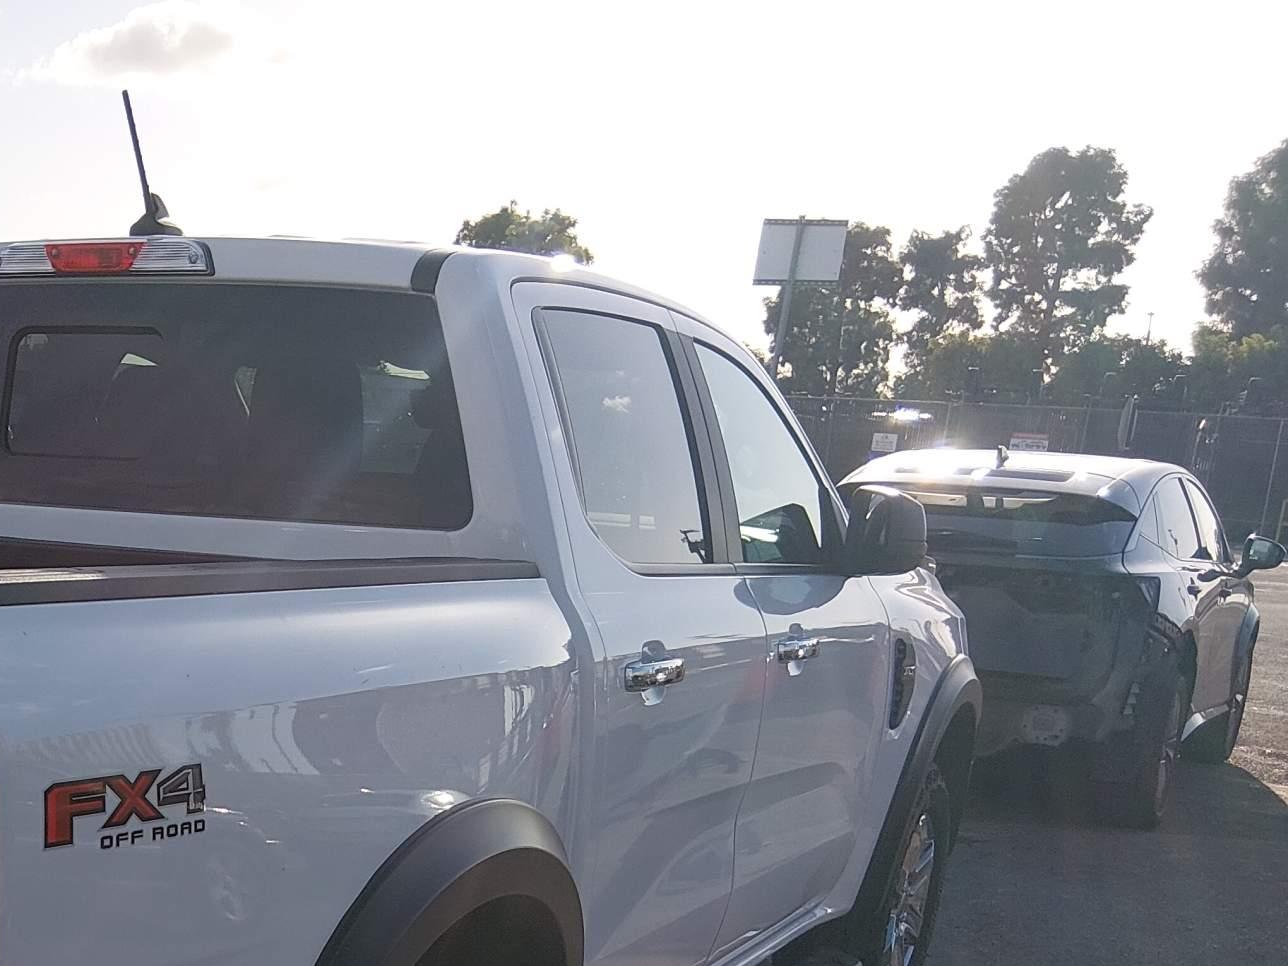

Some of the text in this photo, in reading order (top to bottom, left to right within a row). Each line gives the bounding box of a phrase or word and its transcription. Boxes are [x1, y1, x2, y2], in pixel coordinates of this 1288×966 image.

[43, 762, 207, 849] FX4
[100, 818, 206, 850] OFF ROAD
